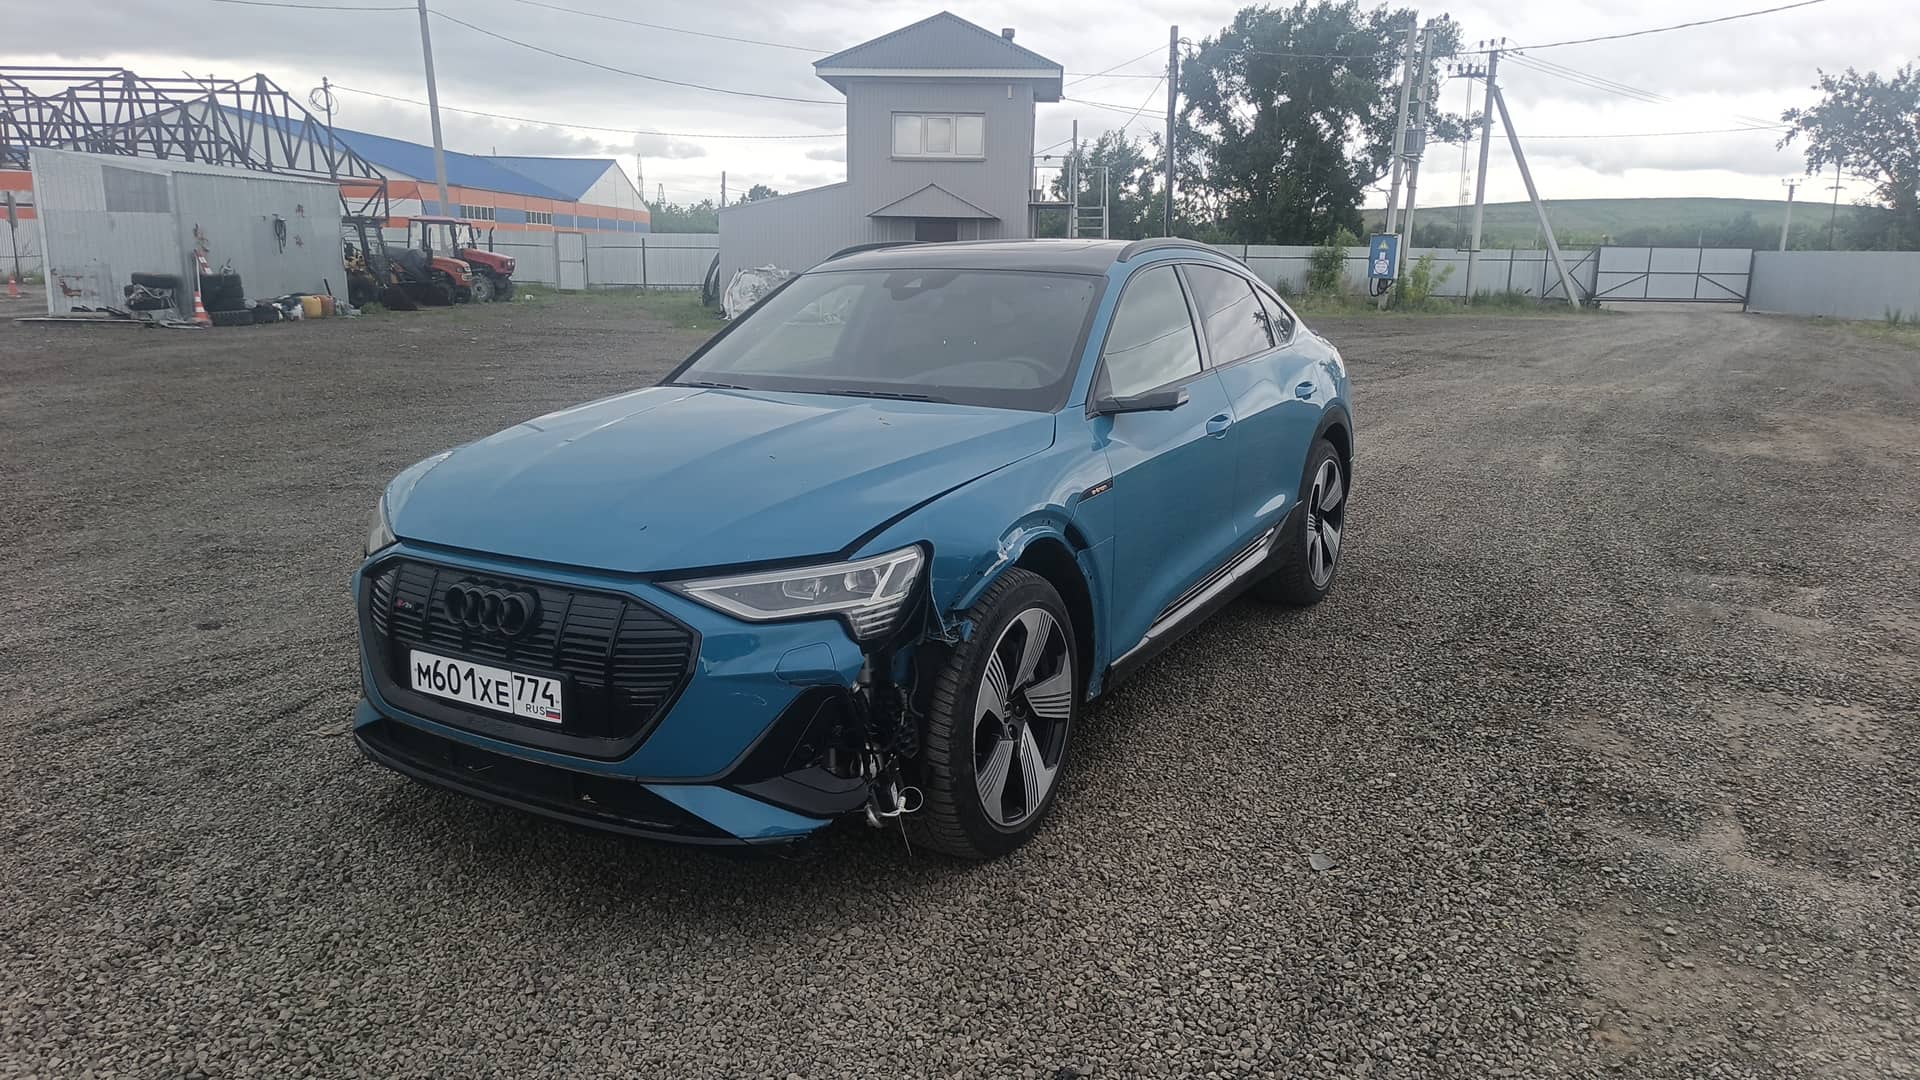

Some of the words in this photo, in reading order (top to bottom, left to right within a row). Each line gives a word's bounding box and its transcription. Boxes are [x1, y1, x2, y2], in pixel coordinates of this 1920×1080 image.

[417, 660, 510, 707] М601ХЕ
[513, 675, 555, 707] 774
[525, 703, 546, 716] RUS
